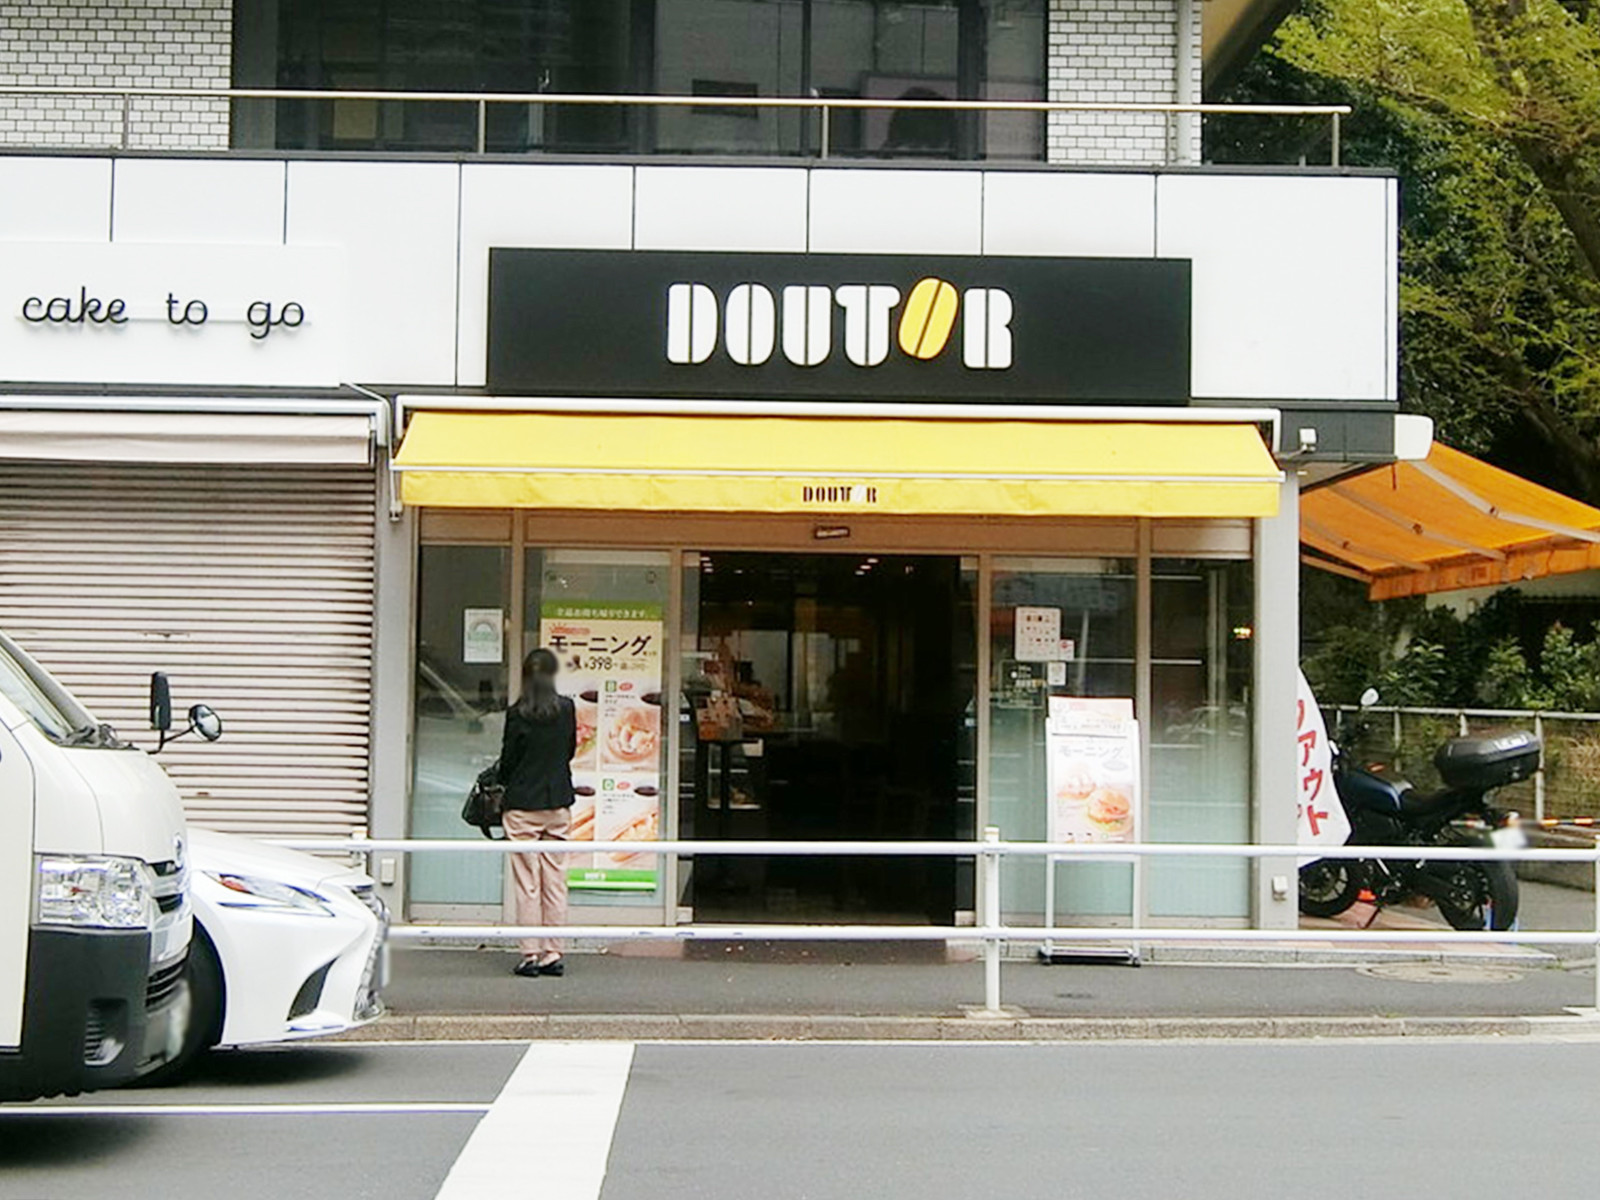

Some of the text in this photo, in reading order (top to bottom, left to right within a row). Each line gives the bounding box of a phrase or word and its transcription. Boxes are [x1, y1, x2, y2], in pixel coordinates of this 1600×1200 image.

[22, 286, 304, 339] cake to go
[667, 278, 1013, 369] DOUTOR
[803, 485, 877, 503] DOUTOR
[548, 635, 652, 656] モーニング
